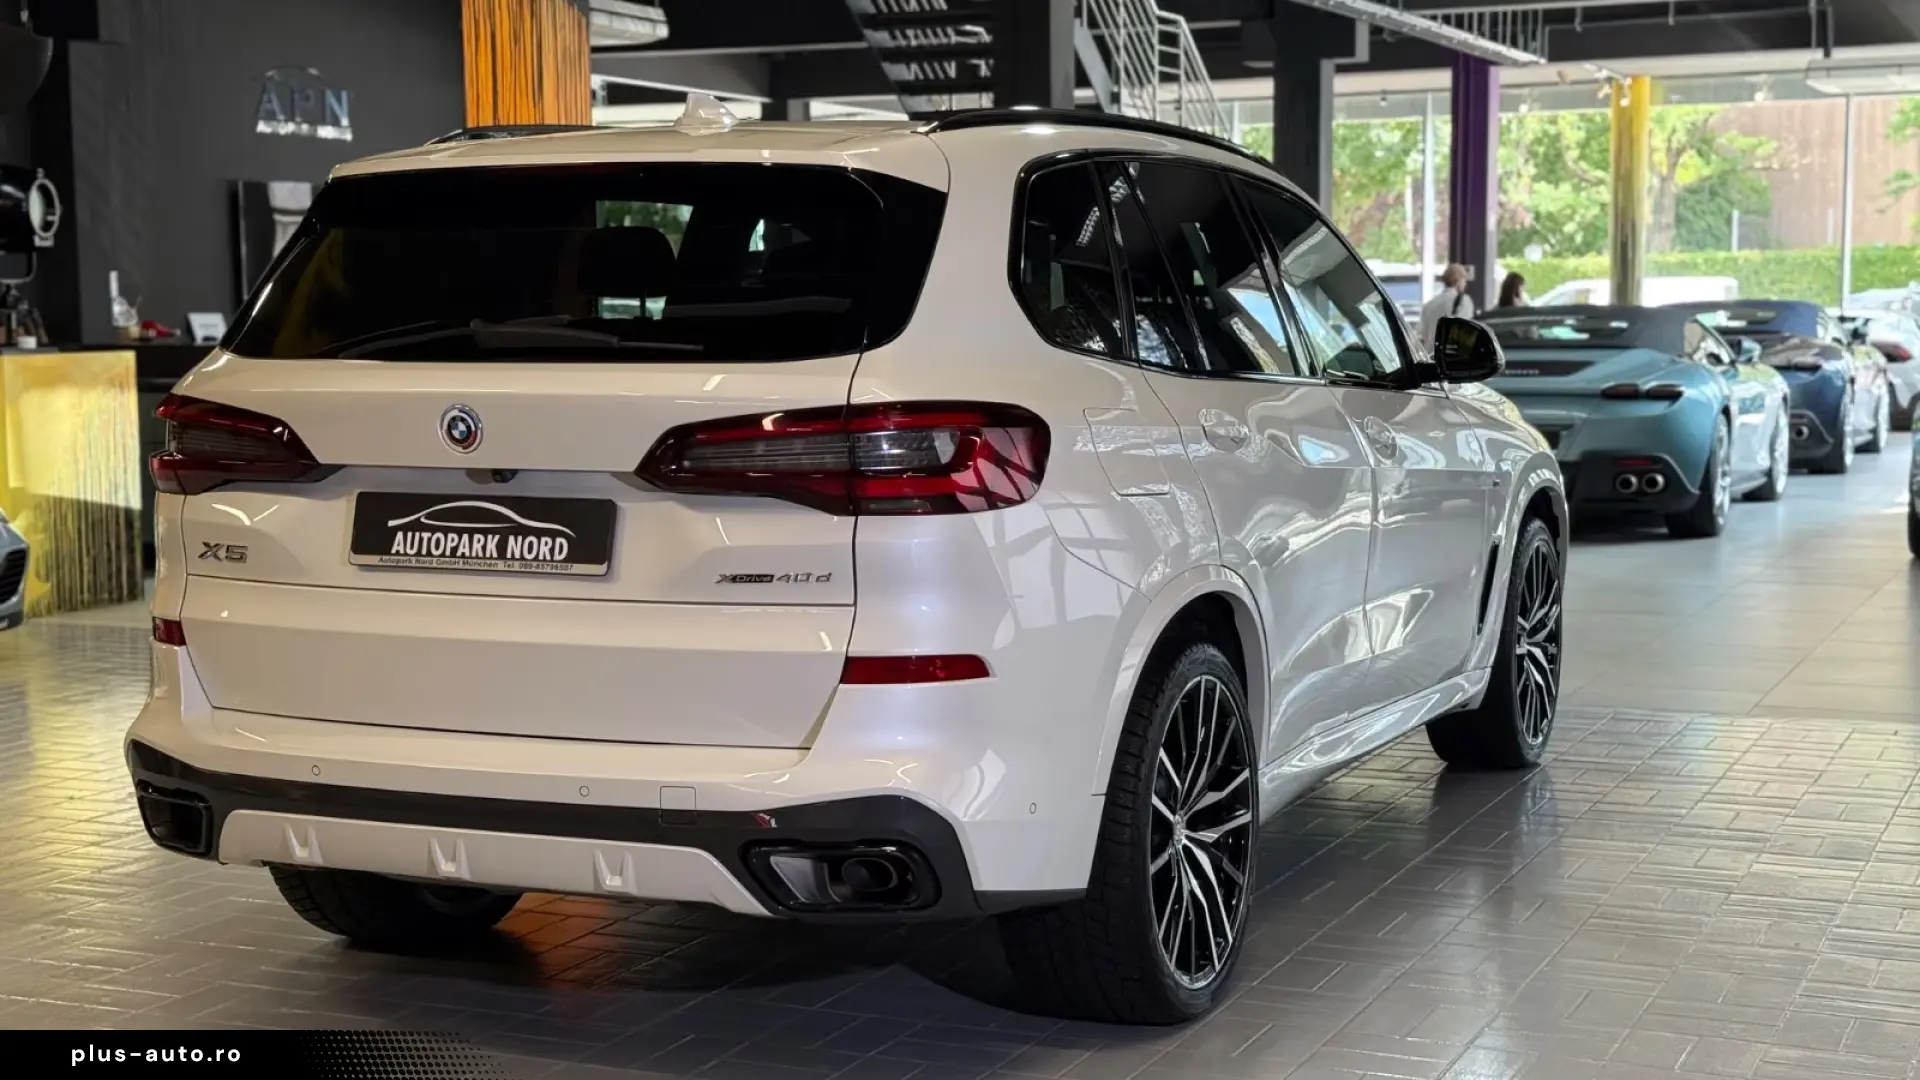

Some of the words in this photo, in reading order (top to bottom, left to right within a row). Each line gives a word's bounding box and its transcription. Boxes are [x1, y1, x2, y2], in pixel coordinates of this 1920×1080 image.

[256, 81, 349, 126] APN
[197, 541, 248, 564] X5
[390, 531, 500, 559] AUTOPARK
[506, 536, 569, 561] NORD
